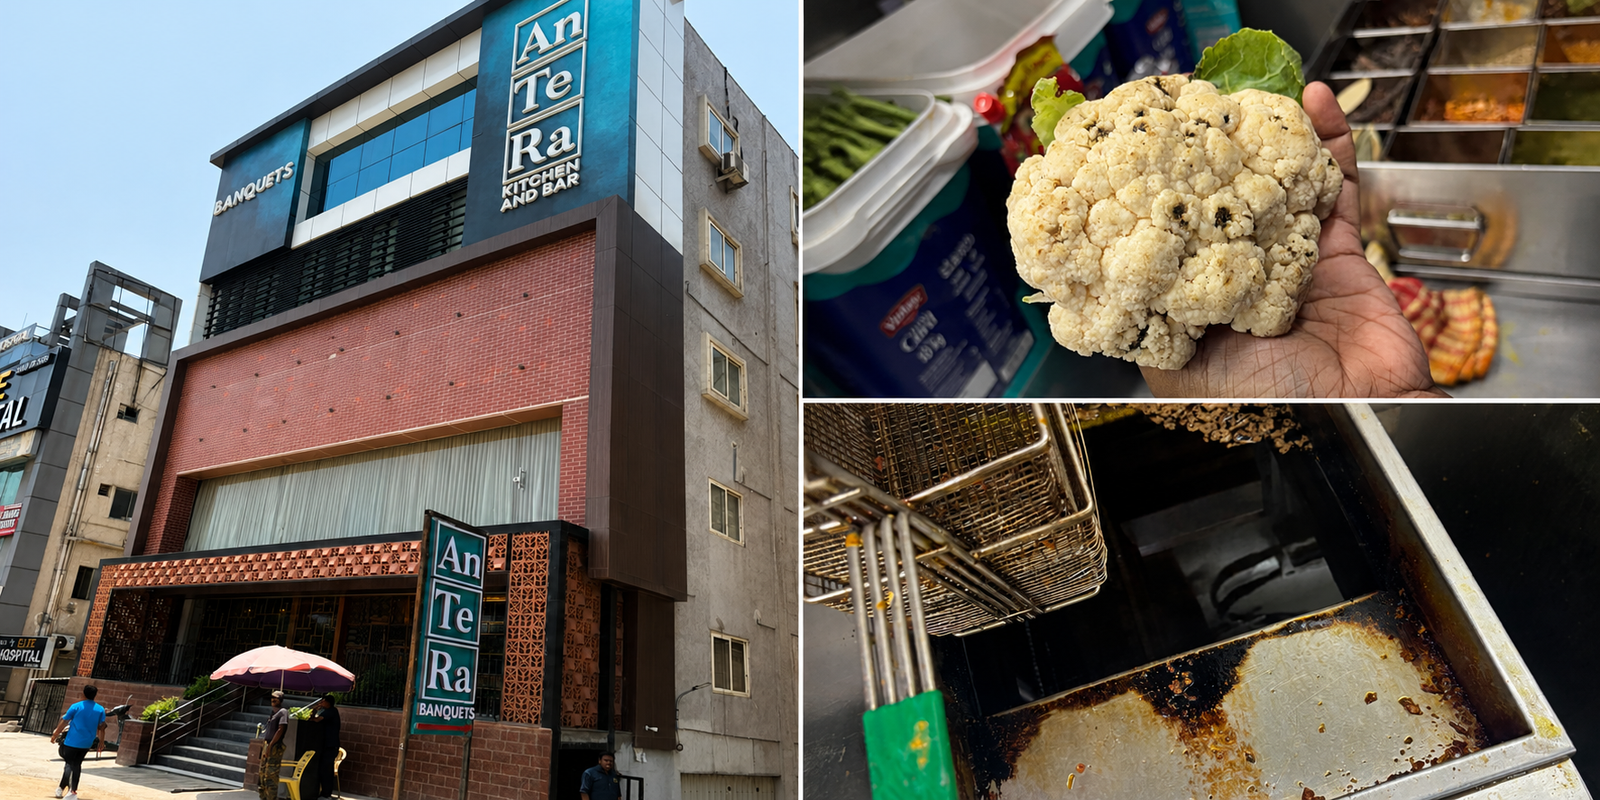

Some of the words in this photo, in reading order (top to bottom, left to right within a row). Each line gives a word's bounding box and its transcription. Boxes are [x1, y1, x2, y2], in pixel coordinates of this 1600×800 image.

[516, 11, 583, 66] An
[514, 66, 574, 115] Te
[508, 126, 576, 174] Ra
[213, 161, 295, 217] BANQUETS
[500, 189, 539, 213] AND
[542, 172, 580, 198] BAR
[502, 158, 581, 199] KITCHEN
[0, 396, 26, 431] AL
[437, 535, 481, 580] An
[434, 588, 474, 634] Te
[427, 649, 472, 694] Ra
[418, 702, 476, 720] BANQUETS
